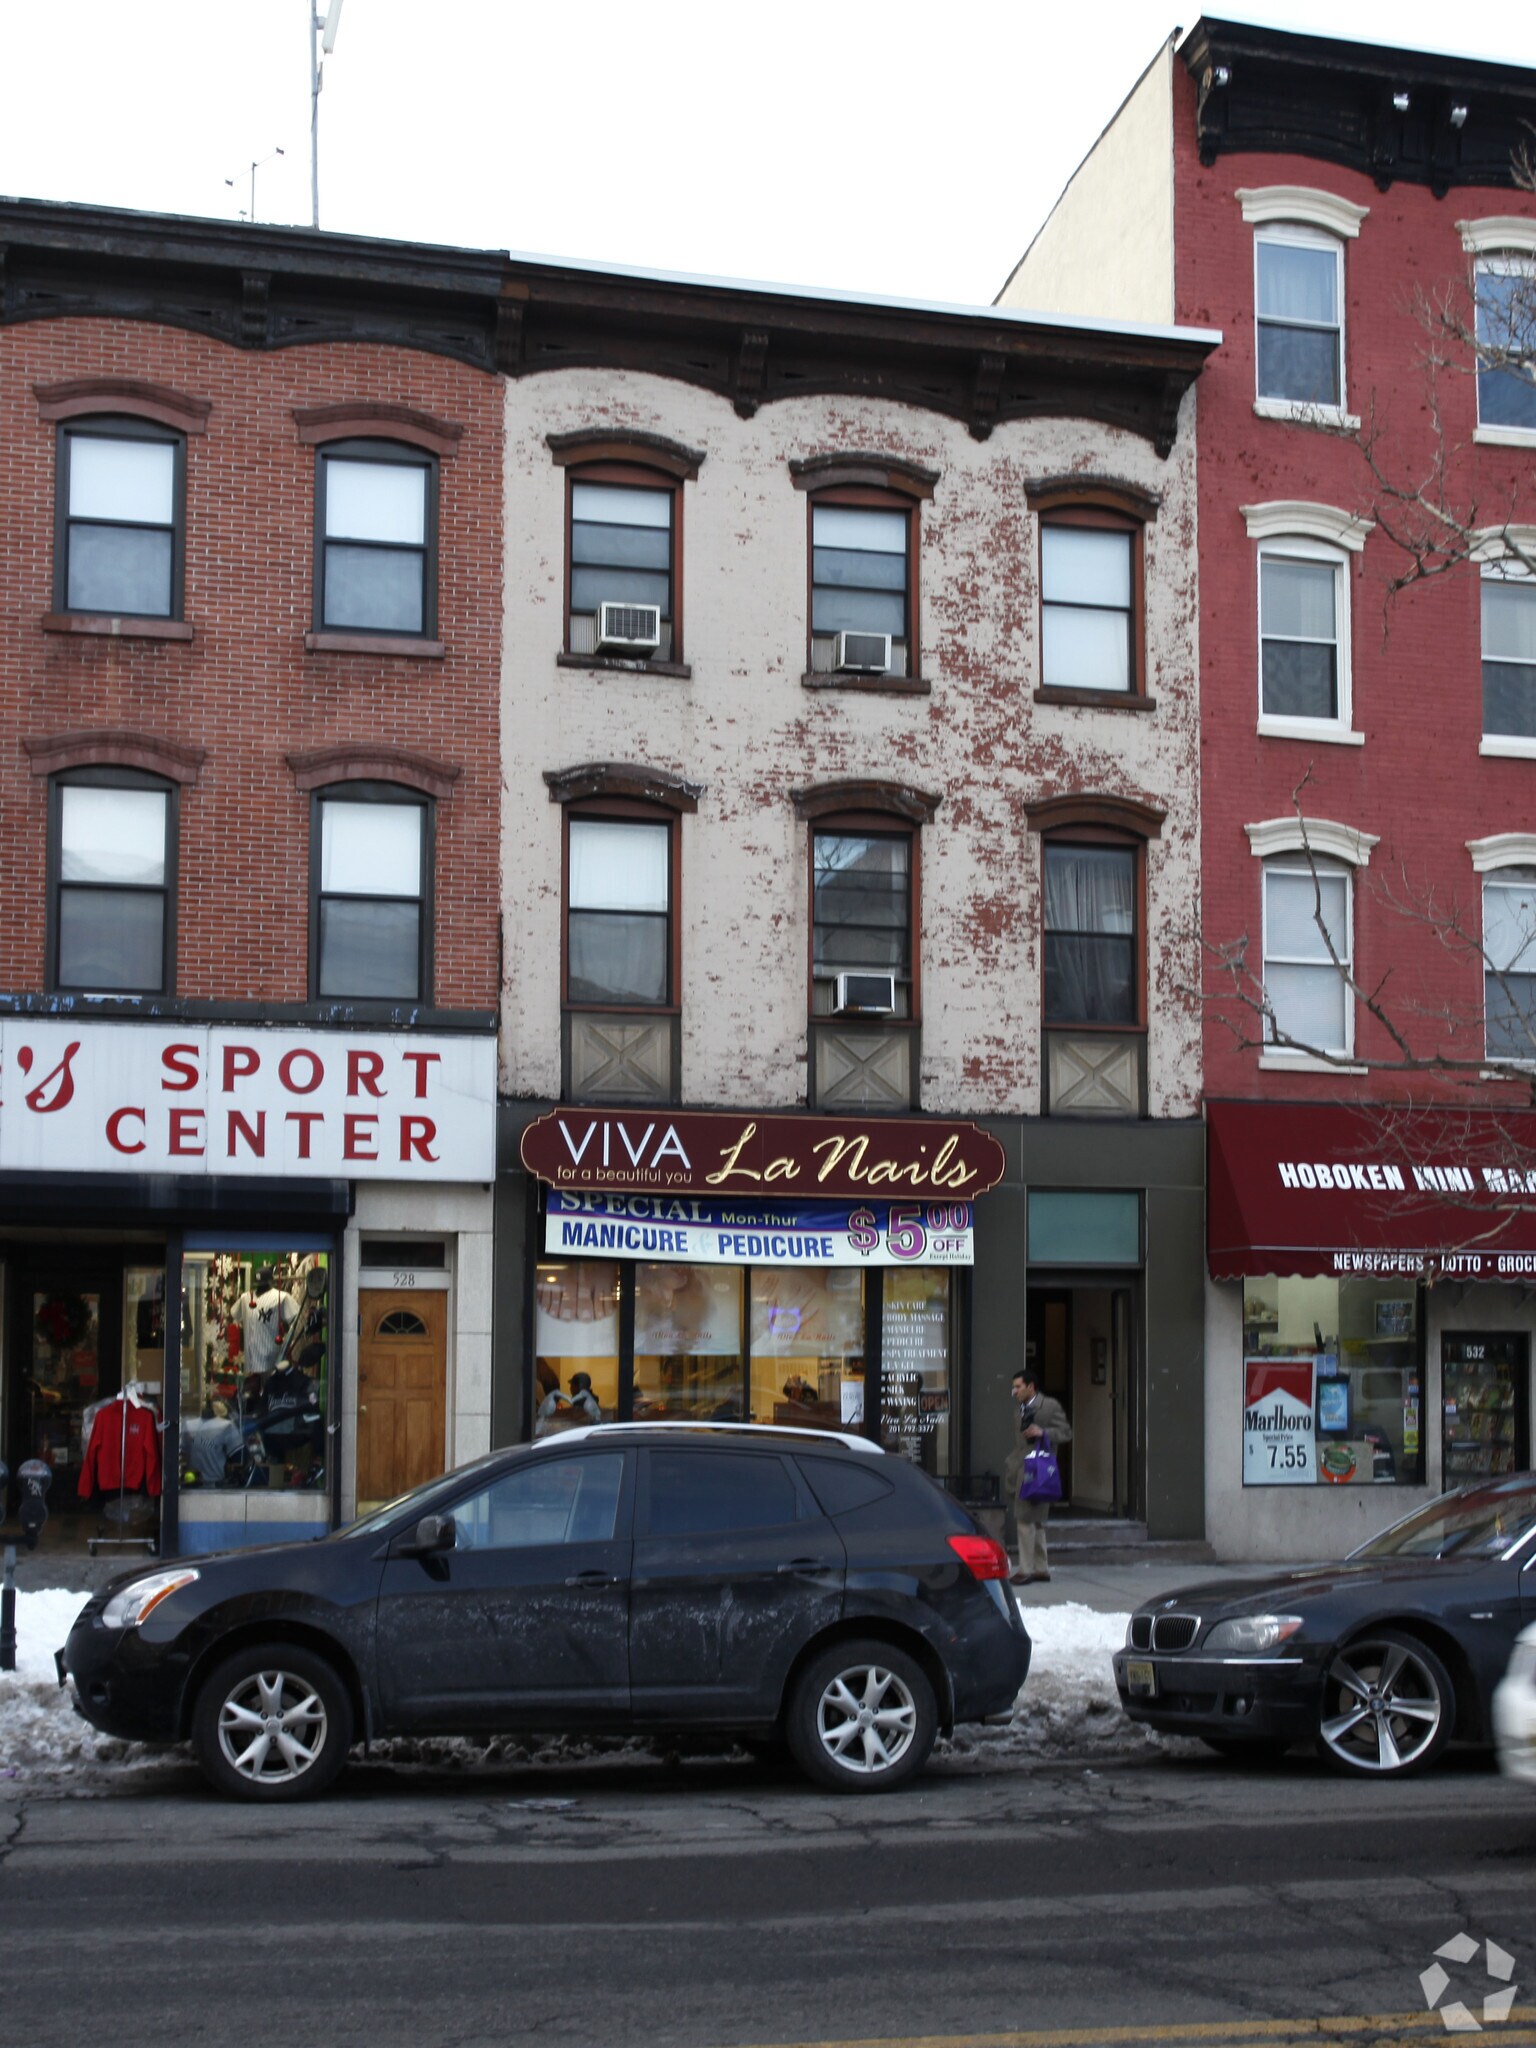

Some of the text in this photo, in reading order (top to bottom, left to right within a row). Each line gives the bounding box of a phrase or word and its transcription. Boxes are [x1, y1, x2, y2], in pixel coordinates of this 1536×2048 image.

[161, 1043, 442, 1099] SPORT
[105, 1106, 441, 1163] CENTER
[558, 1120, 978, 1188] VIVA La Nails
[557, 1165, 692, 1185] for a beautiful you
[1277, 1162, 1406, 1191] HOBOKEN
[1411, 1166, 1475, 1192] MINI
[560, 1191, 798, 1227] SPECIAL Mon-Thur
[561, 1221, 689, 1252] MANICURE
[718, 1234, 835, 1258] PEDICURE
[932, 1239, 965, 1252] OFF
[929, 1253, 949, 1261] Except
[1333, 1253, 1536, 1272] NEWSPAPERS LOTTO GROC
[393, 1271, 415, 1288] 528
[1466, 1346, 1485, 1359] 532
[921, 1395, 948, 1411] OPEN
[1244, 1404, 1312, 1431] Marlboro
[1267, 1445, 1307, 1468] 7.55
